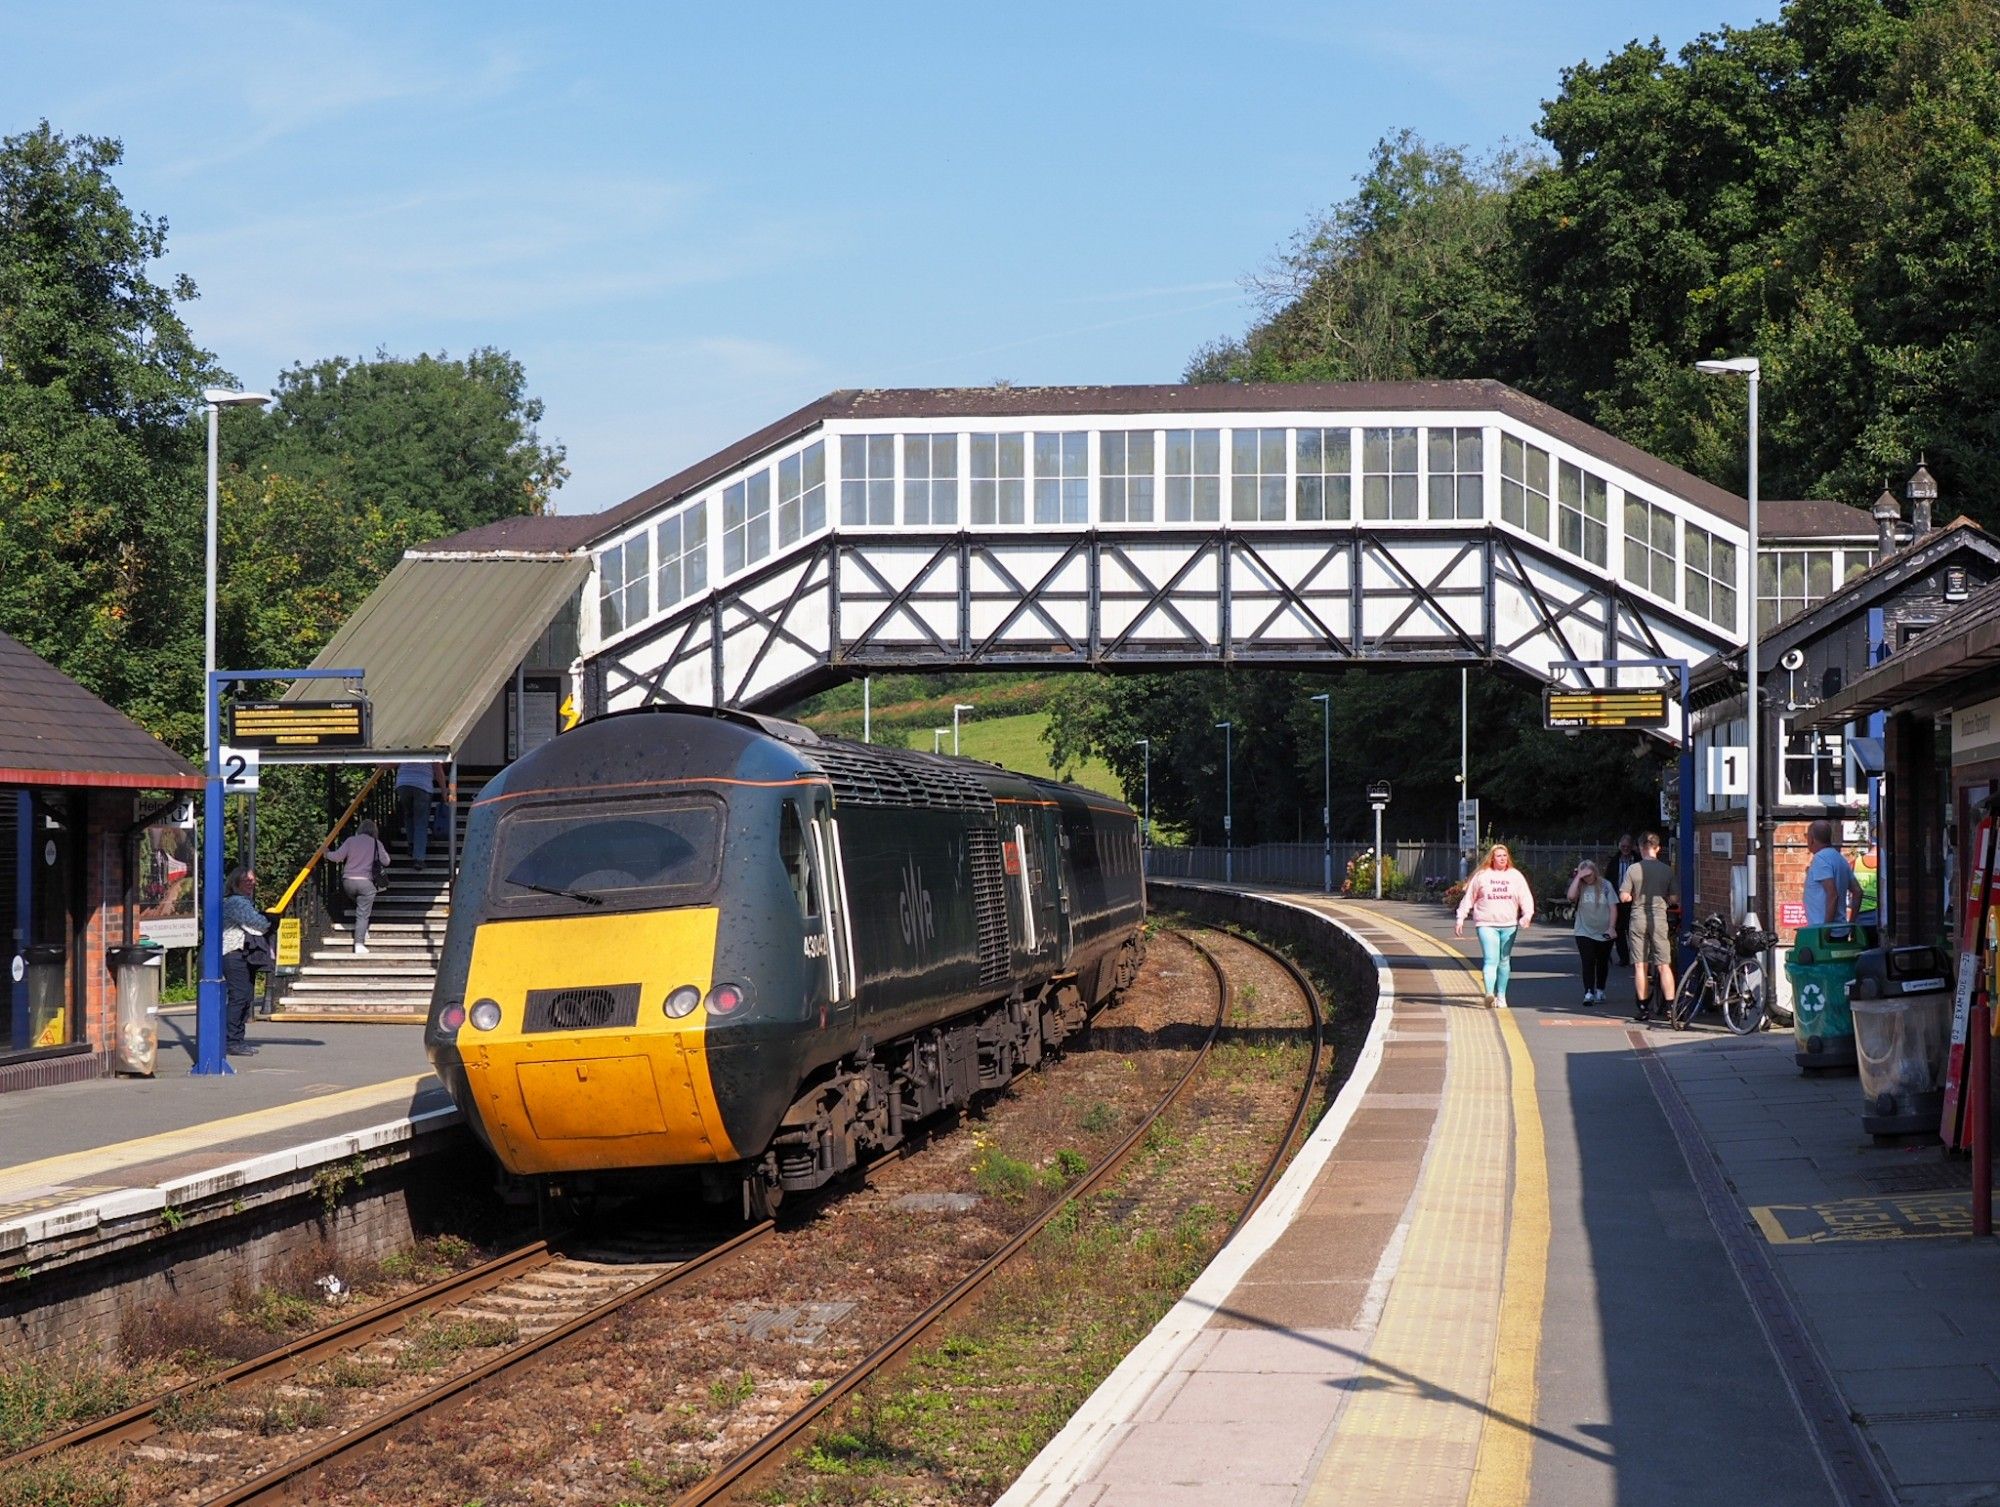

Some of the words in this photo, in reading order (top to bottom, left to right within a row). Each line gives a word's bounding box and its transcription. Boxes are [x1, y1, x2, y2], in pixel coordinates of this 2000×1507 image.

[226, 755, 247, 785] 2
[1724, 756, 1736, 786] 1
[139, 801, 165, 814] Help
[900, 850, 935, 953] GWR
[1958, 979, 1967, 995] DUE
[1955, 998, 1964, 1019] EXAM
